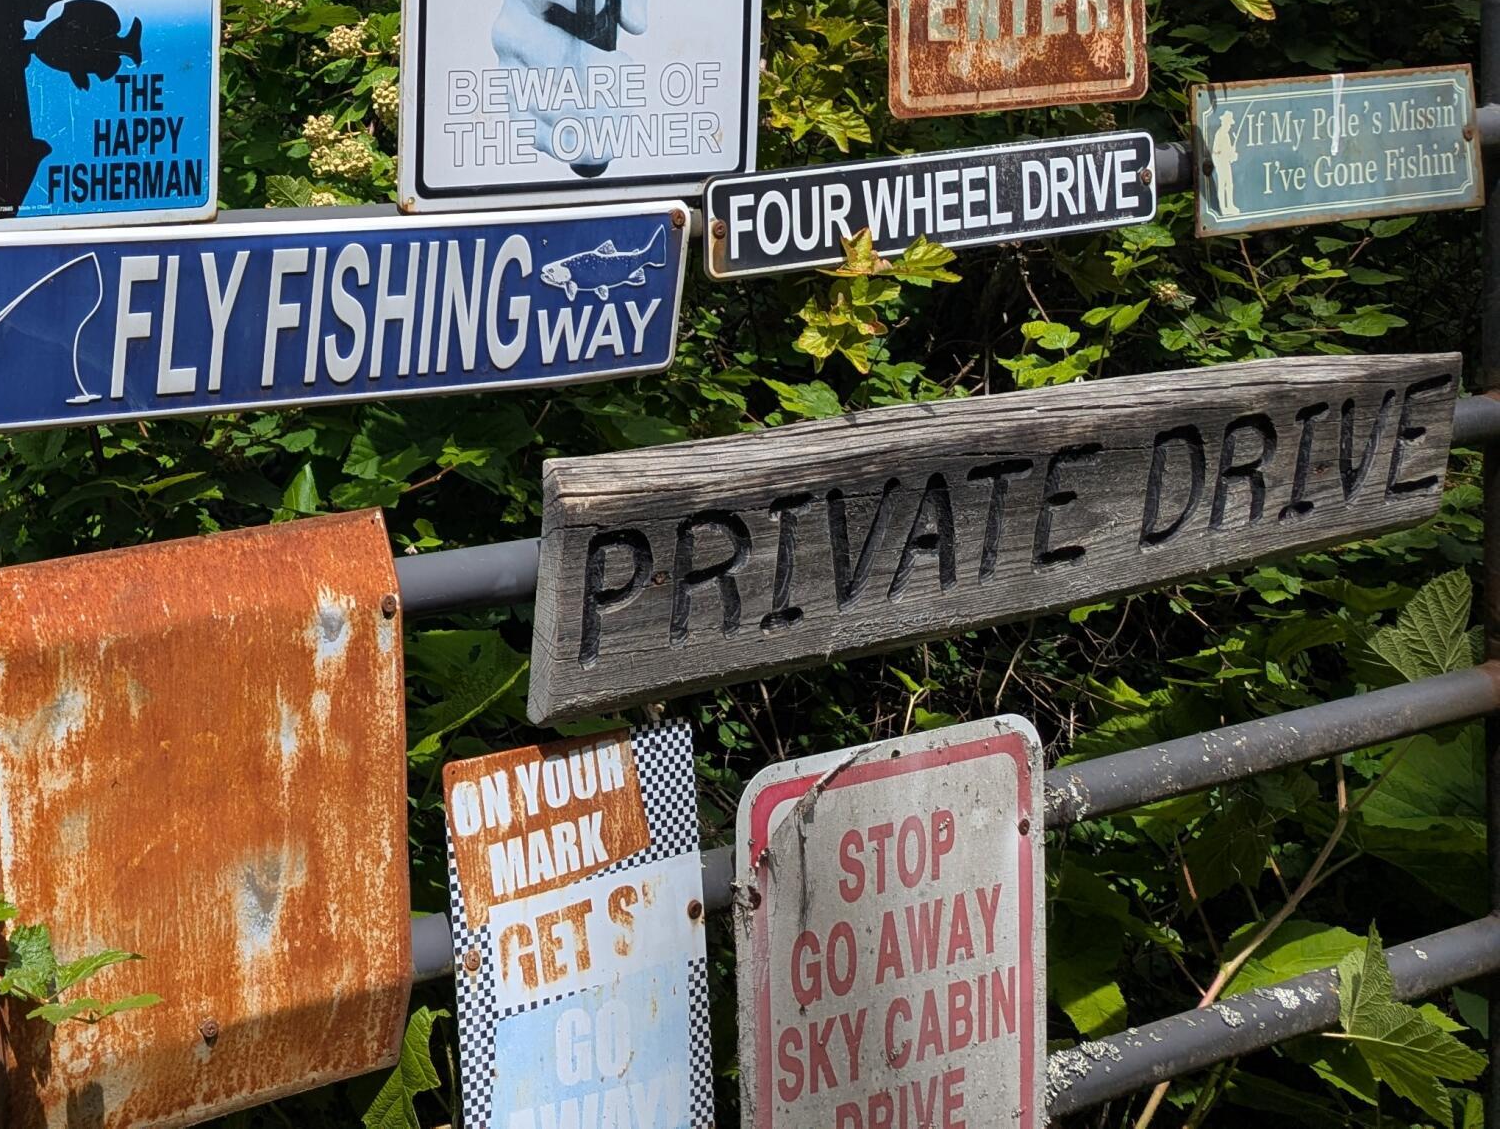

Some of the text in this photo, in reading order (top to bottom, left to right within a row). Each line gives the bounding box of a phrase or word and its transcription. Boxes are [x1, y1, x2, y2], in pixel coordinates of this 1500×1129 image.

[115, 73, 164, 113] THE
[448, 62, 721, 115] BEWARE OF
[1246, 110, 1266, 148] If
[1270, 110, 1305, 151] My
[1388, 93, 1459, 134] Missin'
[47, 158, 203, 204] FISHERMAN
[94, 116, 185, 158] HAPPY
[444, 111, 722, 167] THE OWNER
[1263, 142, 1460, 195] I've Gone Fishin'
[729, 148, 1139, 260] FOUR WHEEL DRIVE
[109, 233, 661, 399] FLY FISHING WAY
[578, 374, 1454, 668] PRIVATE DRIVE
[450, 770, 512, 838] ON
[488, 810, 609, 898] MARK
[838, 808, 956, 904] STOP
[498, 898, 593, 991] GET
[791, 882, 1003, 1007] GO AWAY
[555, 999, 632, 1087] GO
[777, 966, 1017, 1103] SKY CABIN
